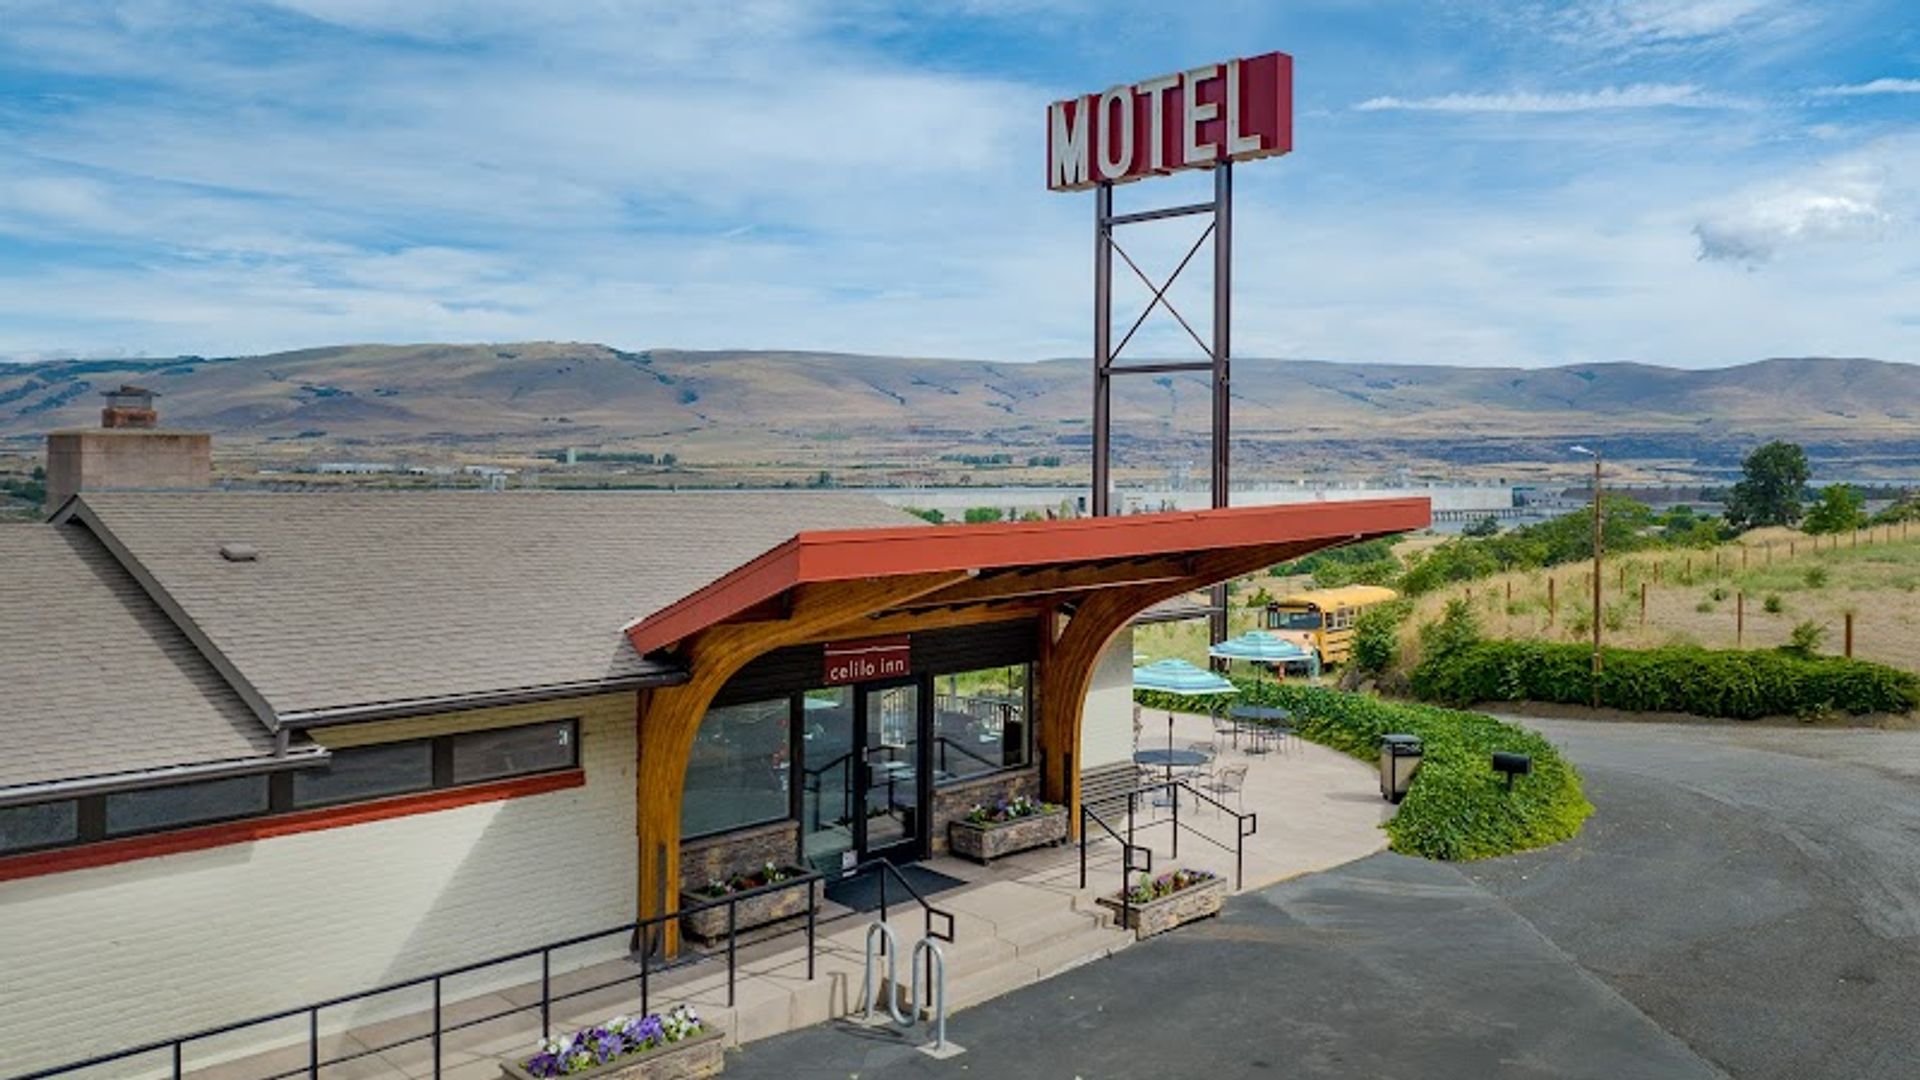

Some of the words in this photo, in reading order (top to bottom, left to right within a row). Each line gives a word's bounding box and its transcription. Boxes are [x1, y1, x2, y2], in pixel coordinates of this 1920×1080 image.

[1051, 58, 1261, 187] MOTEL
[830, 659, 875, 680] celilo
[881, 658, 904, 673] inn
